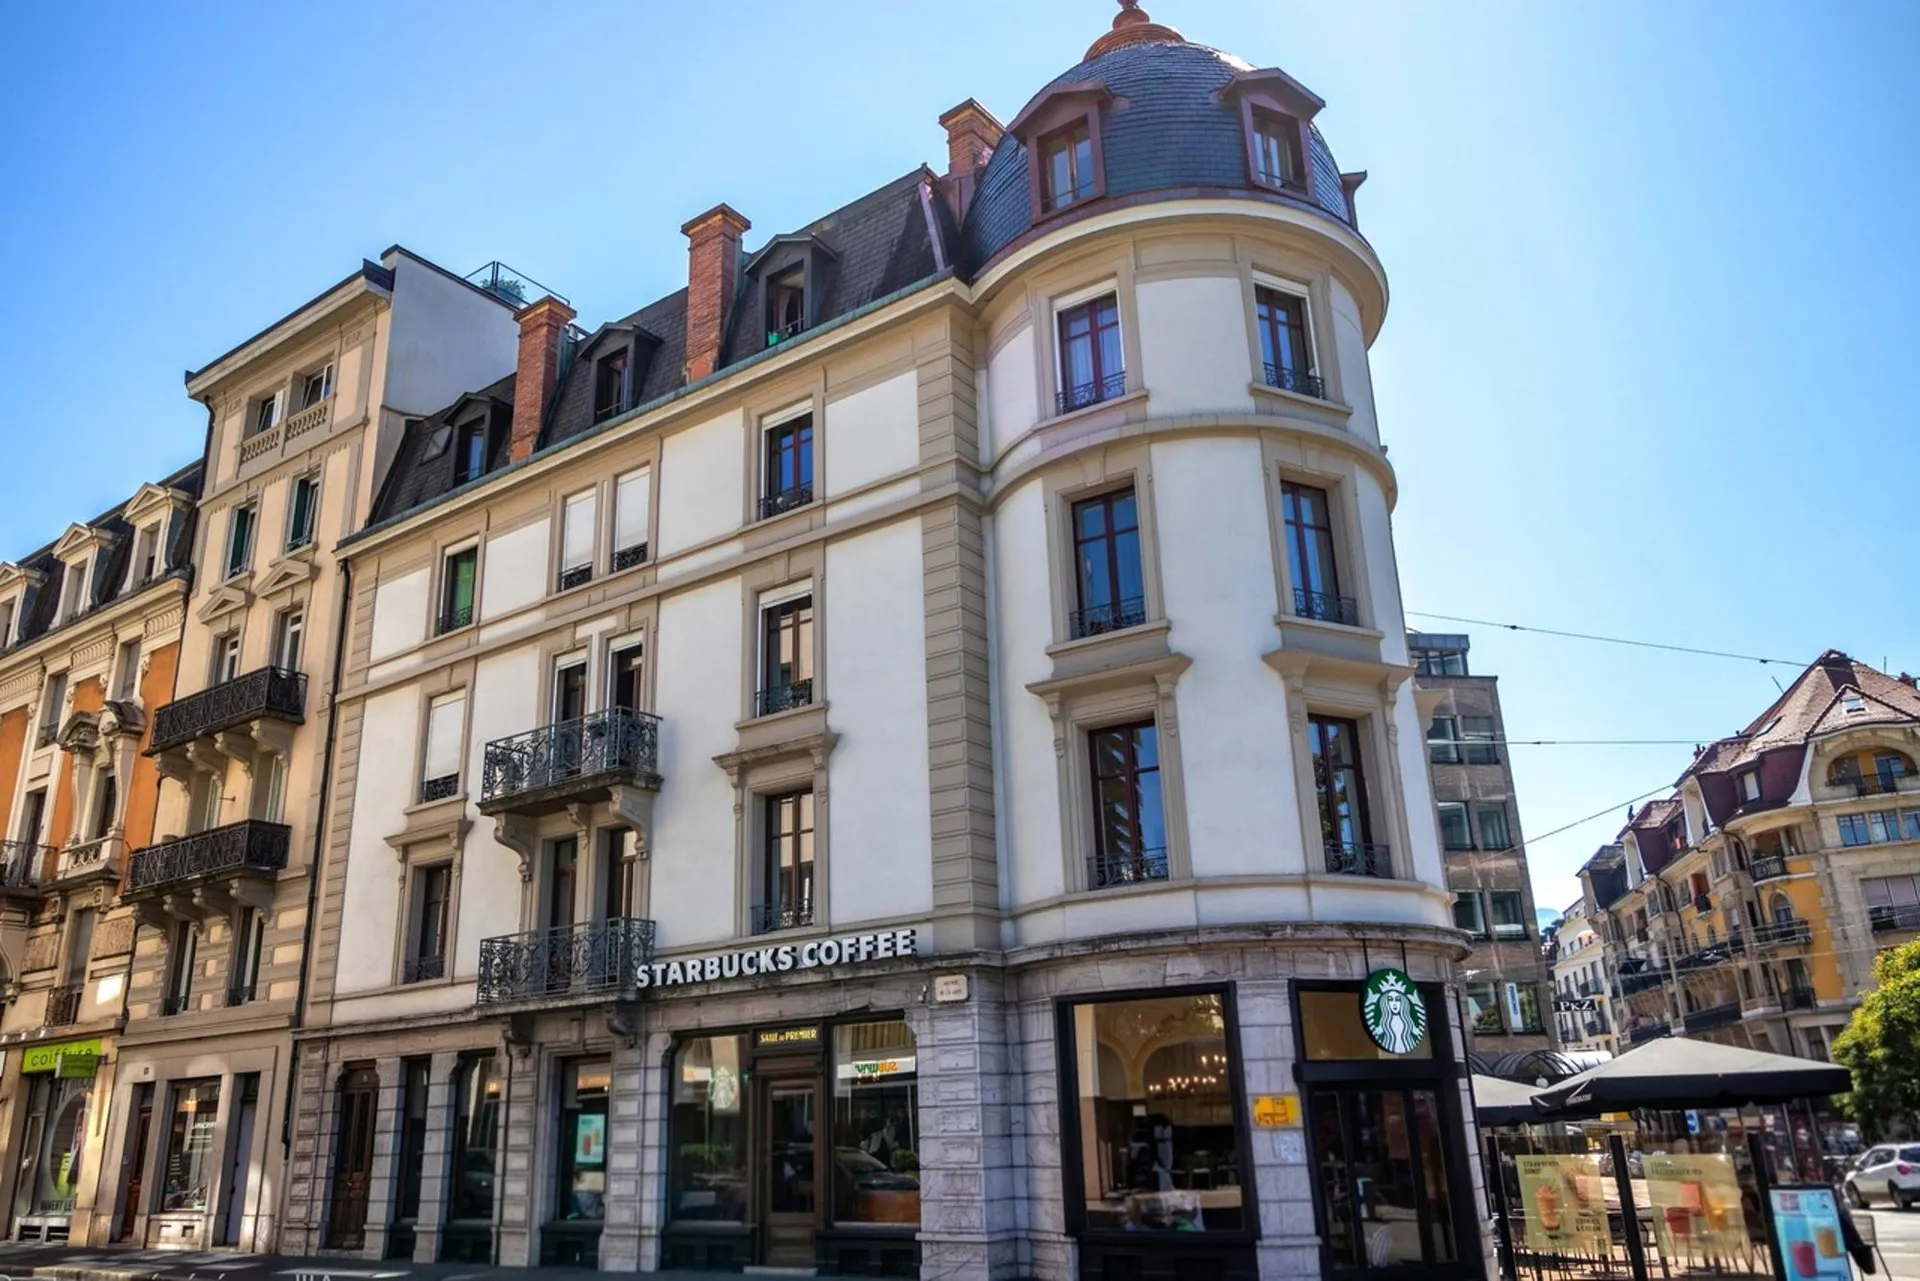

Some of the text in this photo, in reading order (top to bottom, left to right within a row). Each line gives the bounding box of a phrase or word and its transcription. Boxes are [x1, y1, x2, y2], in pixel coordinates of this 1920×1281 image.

[636, 929, 916, 988] STARBUCKS COFFEE
[1560, 1001, 1592, 1012] PKZ
